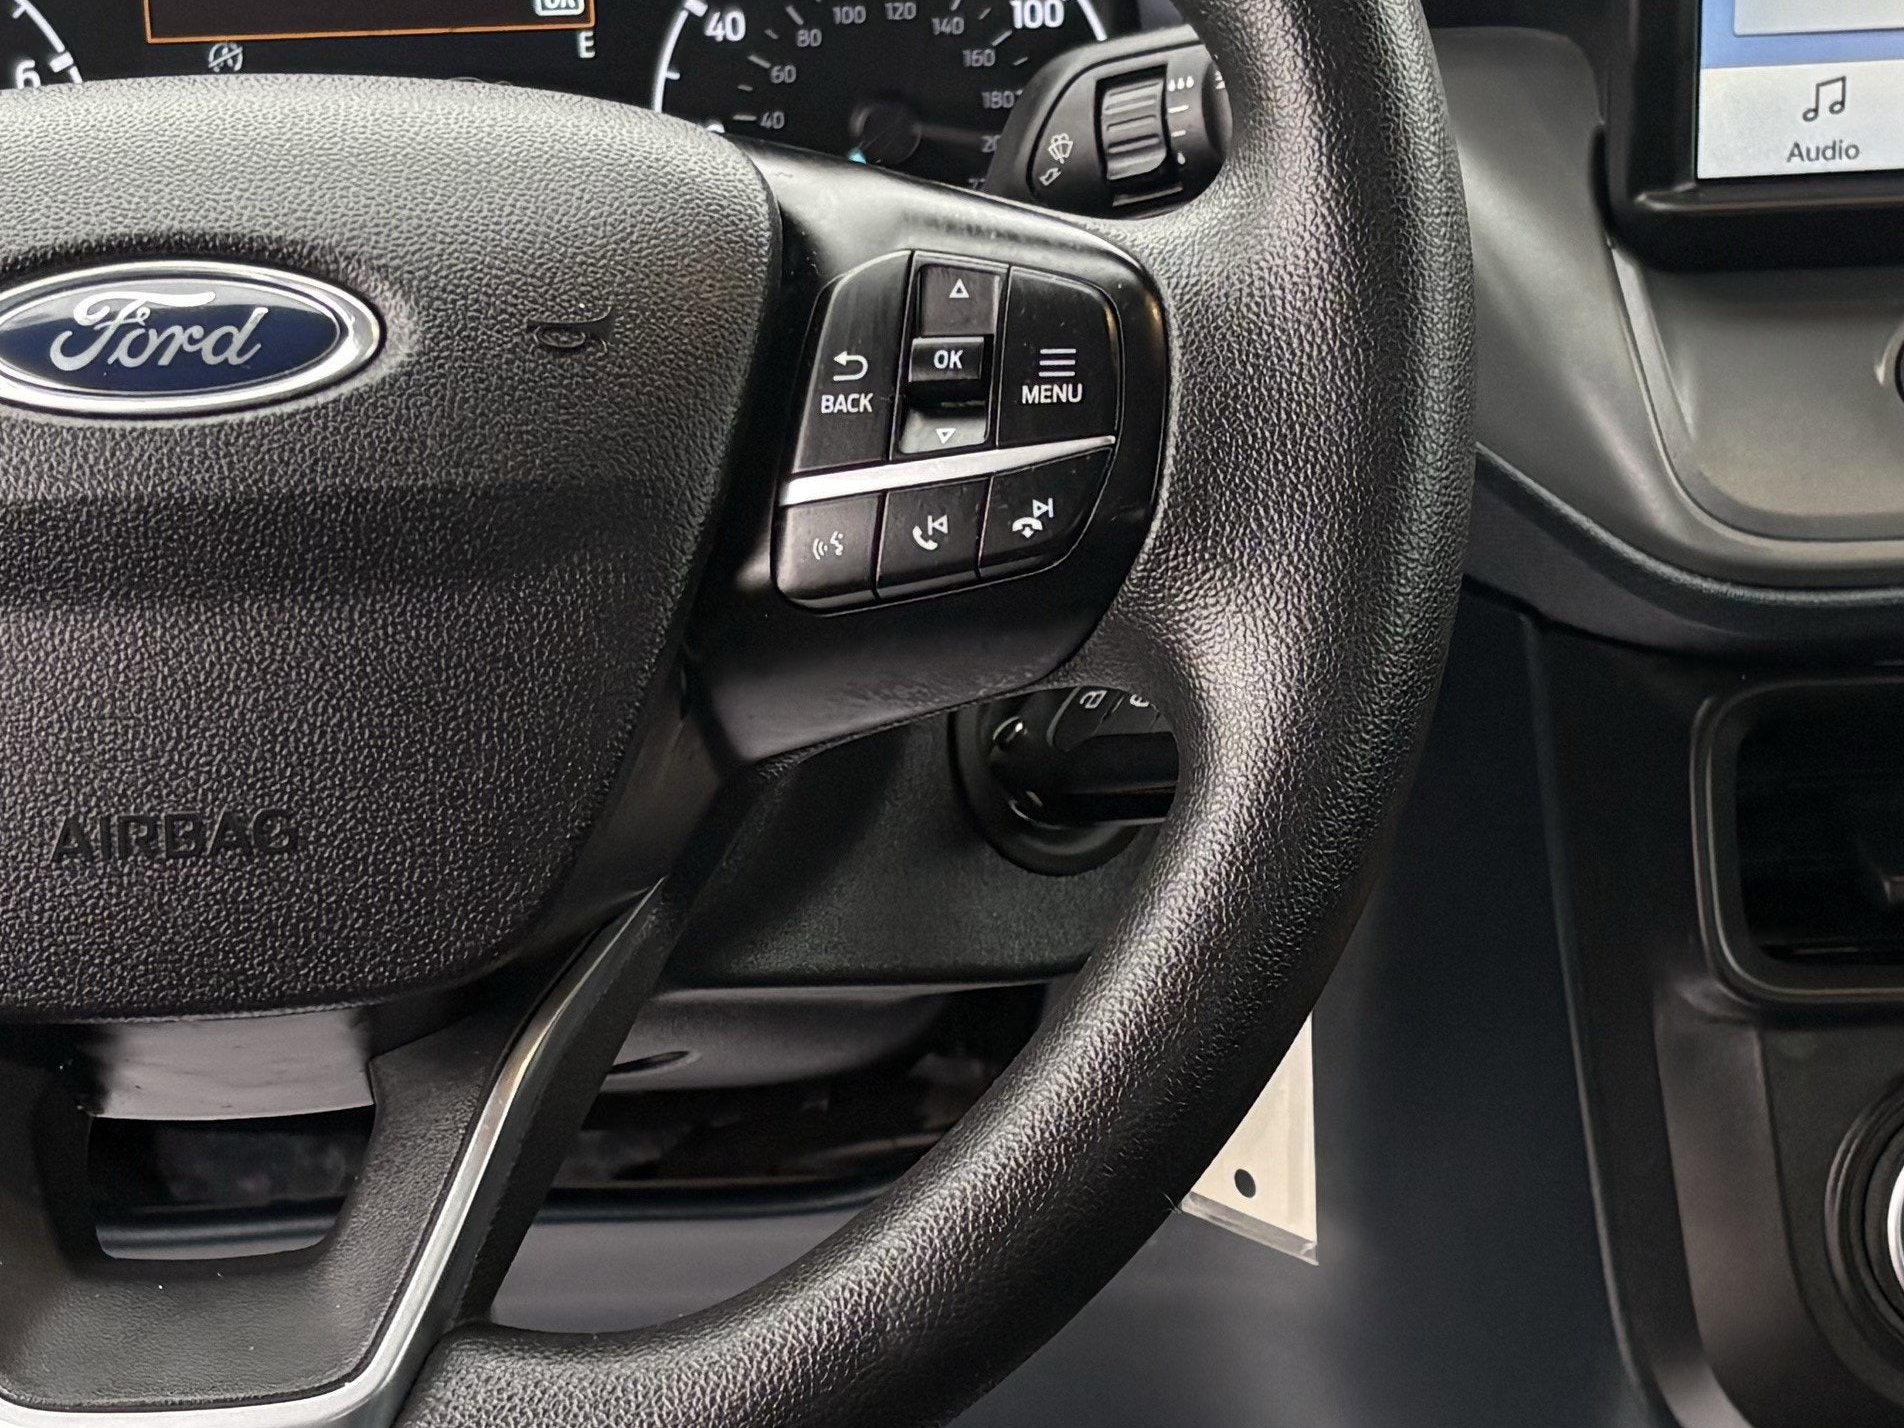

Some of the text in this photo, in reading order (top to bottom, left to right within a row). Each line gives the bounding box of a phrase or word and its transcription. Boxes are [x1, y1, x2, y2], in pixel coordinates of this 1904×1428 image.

[832, 4, 867, 24] 100
[885, 1, 918, 21] 120
[704, 10, 747, 42] 40
[932, 16, 965, 37] 140
[578, 29, 596, 59] E
[795, 28, 823, 49] 80
[962, 48, 996, 68] 160
[15, 59, 42, 89] 6
[770, 64, 797, 85] 60
[981, 90, 1015, 110] 180
[759, 110, 786, 130] 40
[1785, 137, 1861, 166] Audio
[48, 289, 269, 373] Ford
[932, 348, 964, 371] OK
[820, 392, 874, 415] BACK
[1021, 383, 1084, 406] MENU
[48, 807, 298, 864] AIRBAG
